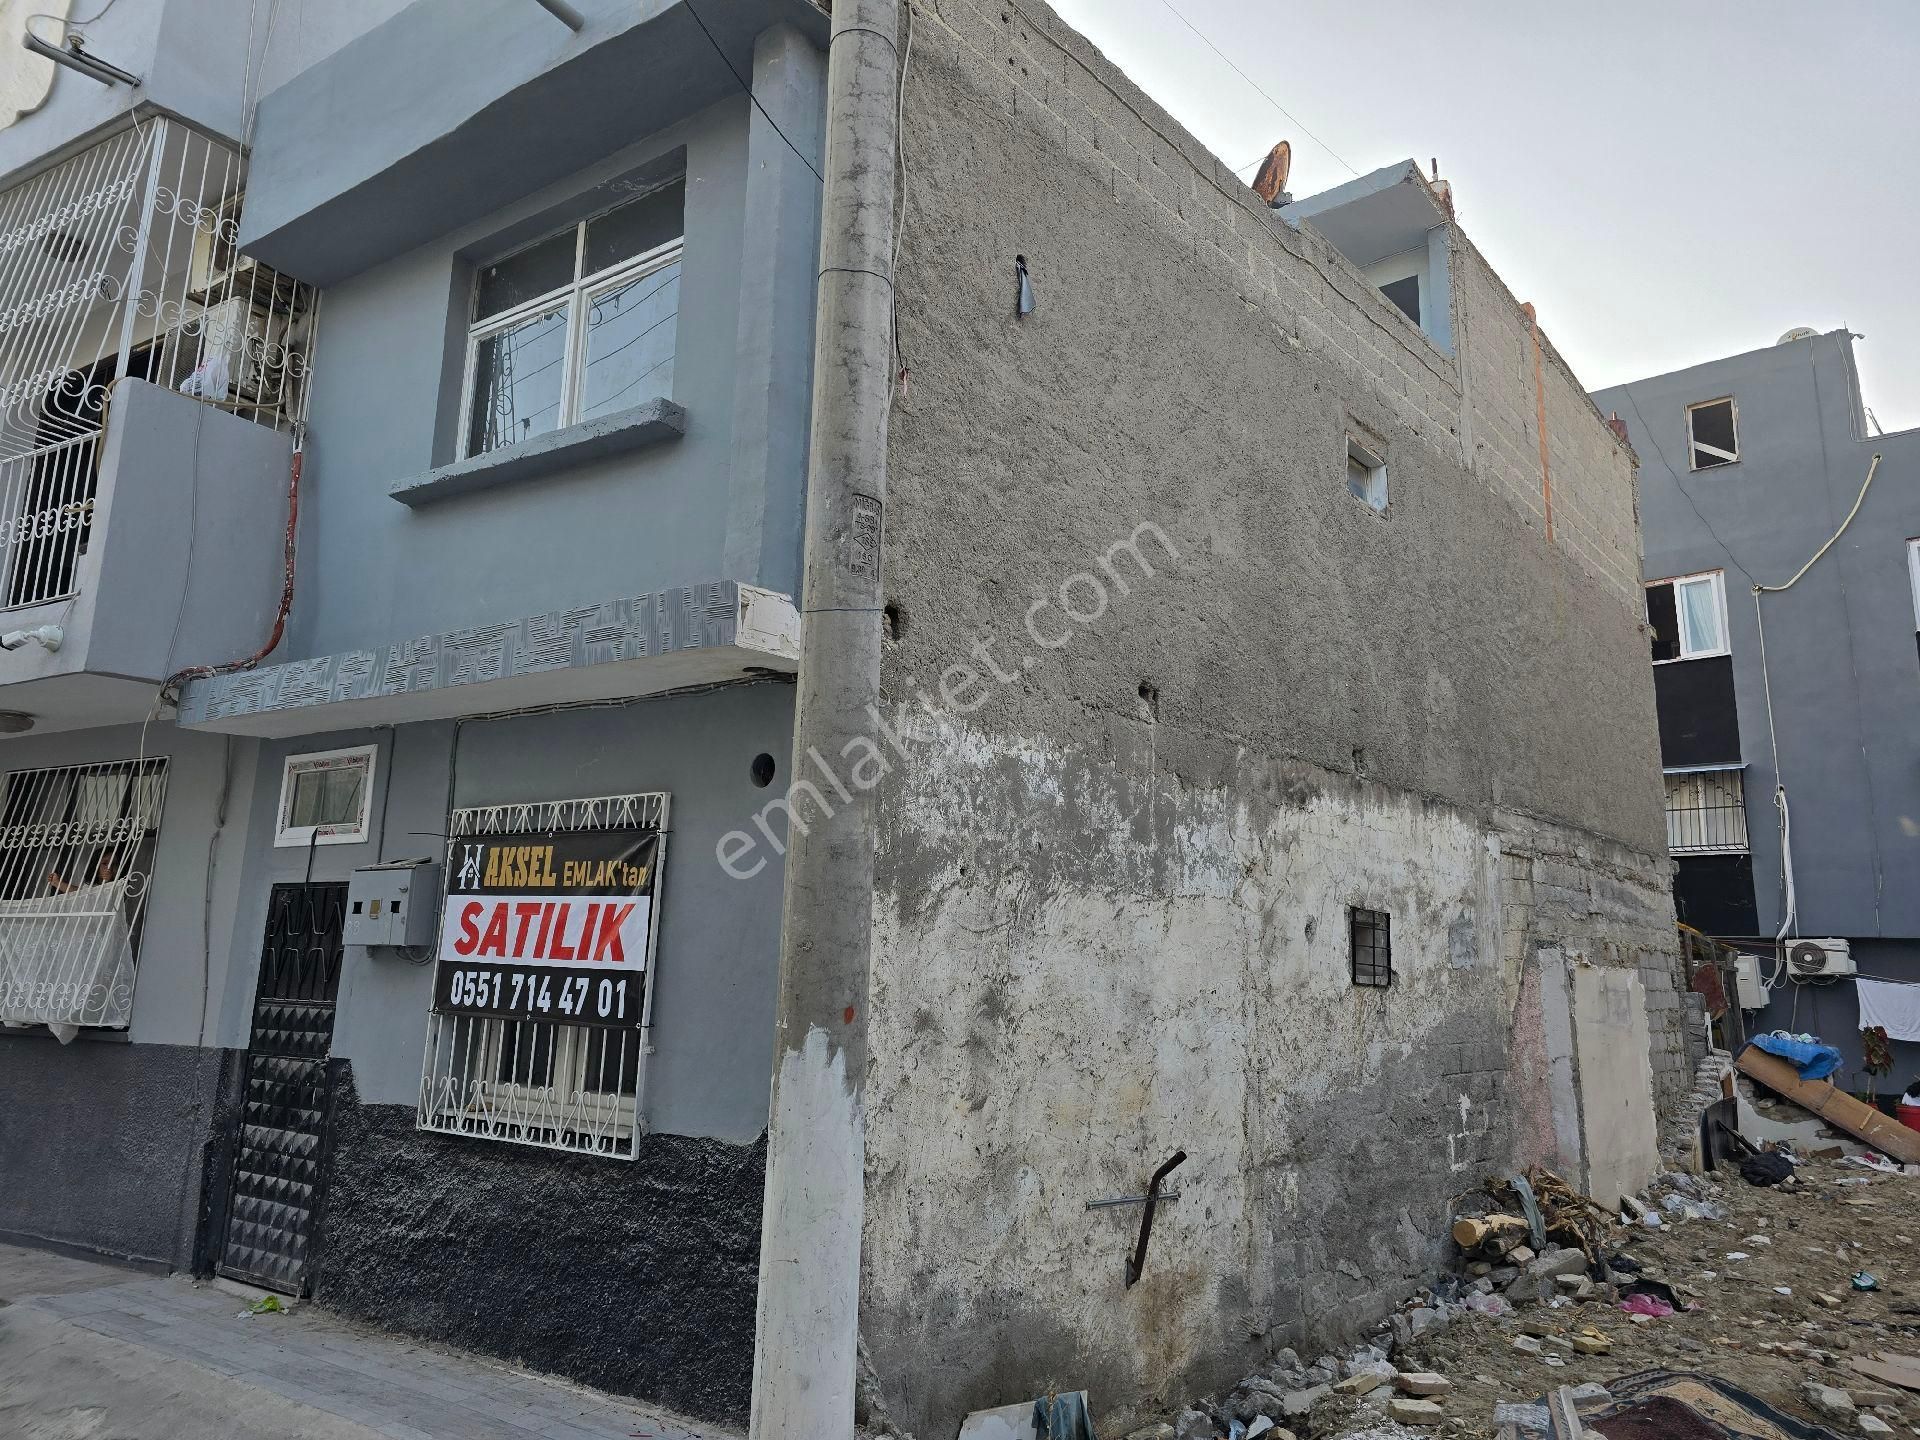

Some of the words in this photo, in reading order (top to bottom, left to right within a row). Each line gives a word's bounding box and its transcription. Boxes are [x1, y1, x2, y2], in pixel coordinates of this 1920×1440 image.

[483, 845, 556, 887] AKSEL
[563, 859, 648, 887] EMLAK'tan
[454, 901, 636, 962] SATILIK
[450, 970, 501, 1009] 0551
[510, 973, 551, 1013] 714
[558, 977, 590, 1015] 47
[598, 978, 627, 1019] 01
